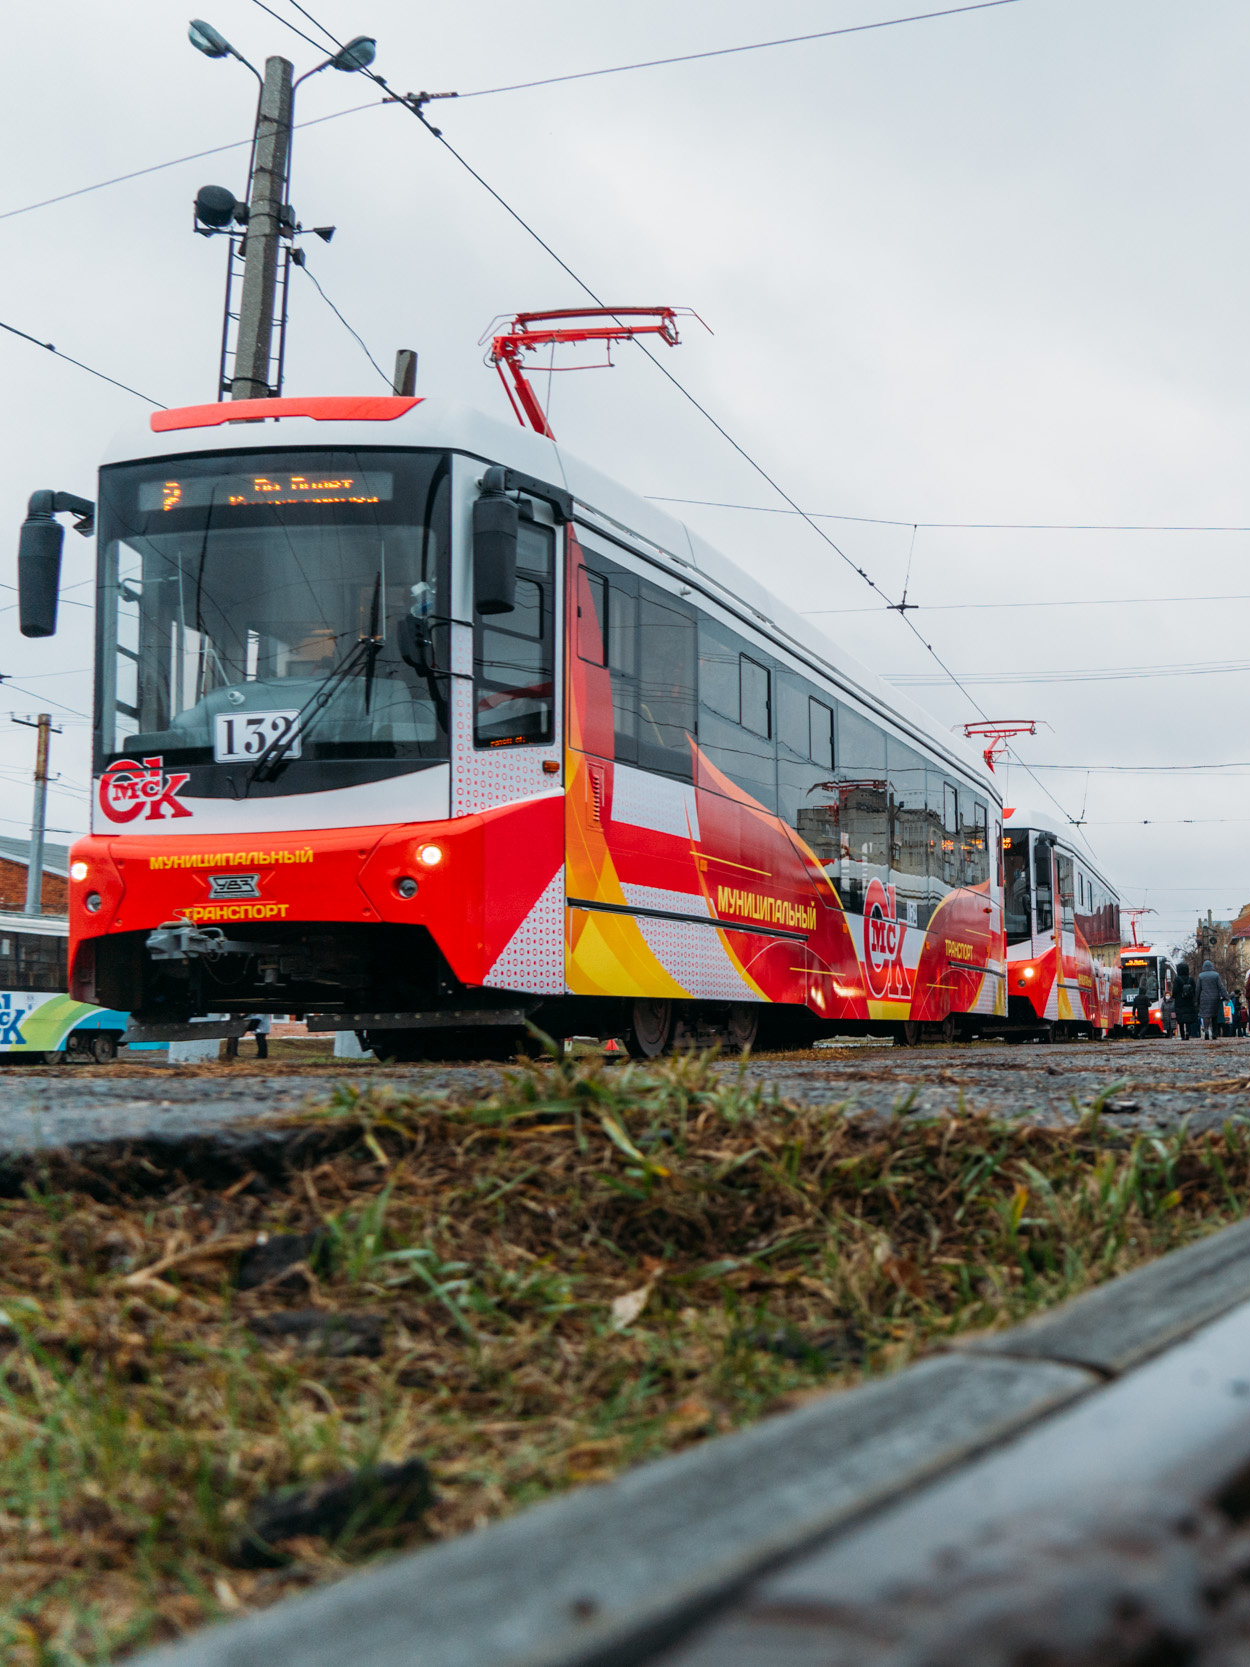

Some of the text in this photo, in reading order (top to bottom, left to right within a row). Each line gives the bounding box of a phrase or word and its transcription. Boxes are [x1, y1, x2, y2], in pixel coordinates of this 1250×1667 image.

[222, 716, 294, 756] 132
[150, 846, 314, 870] МУНИЦИПАЛЬНЫЙ
[182, 904, 289, 921] ТРАНСПОРТ
[717, 885, 817, 931] МУНИЦИПАЛЬНЫЙ
[944, 939, 974, 961] ТРАНСПОРТ
